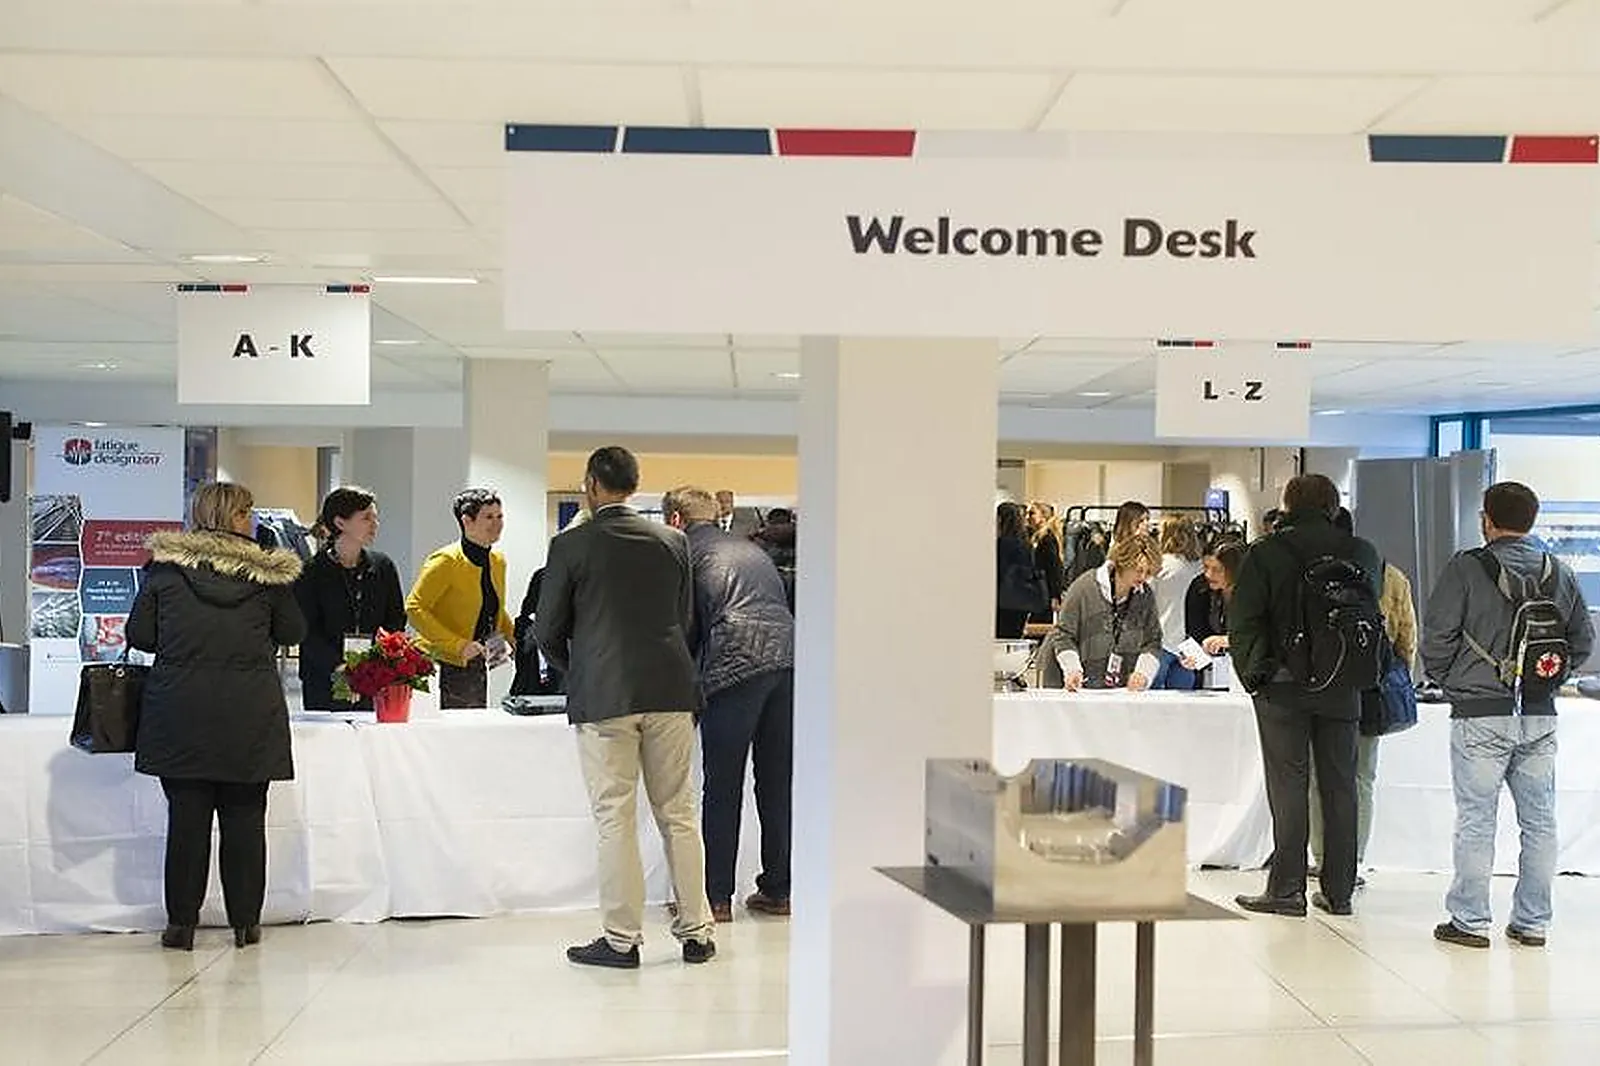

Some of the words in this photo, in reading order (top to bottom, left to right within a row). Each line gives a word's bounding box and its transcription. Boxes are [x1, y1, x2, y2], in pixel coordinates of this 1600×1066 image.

[846, 215, 1103, 257] Welcome
[1123, 218, 1257, 258] Desk
[232, 335, 258, 358] A
[290, 334, 315, 358] K
[1204, 381, 1219, 400] L
[1244, 381, 1263, 400] Z
[94, 439, 139, 454] fatigue
